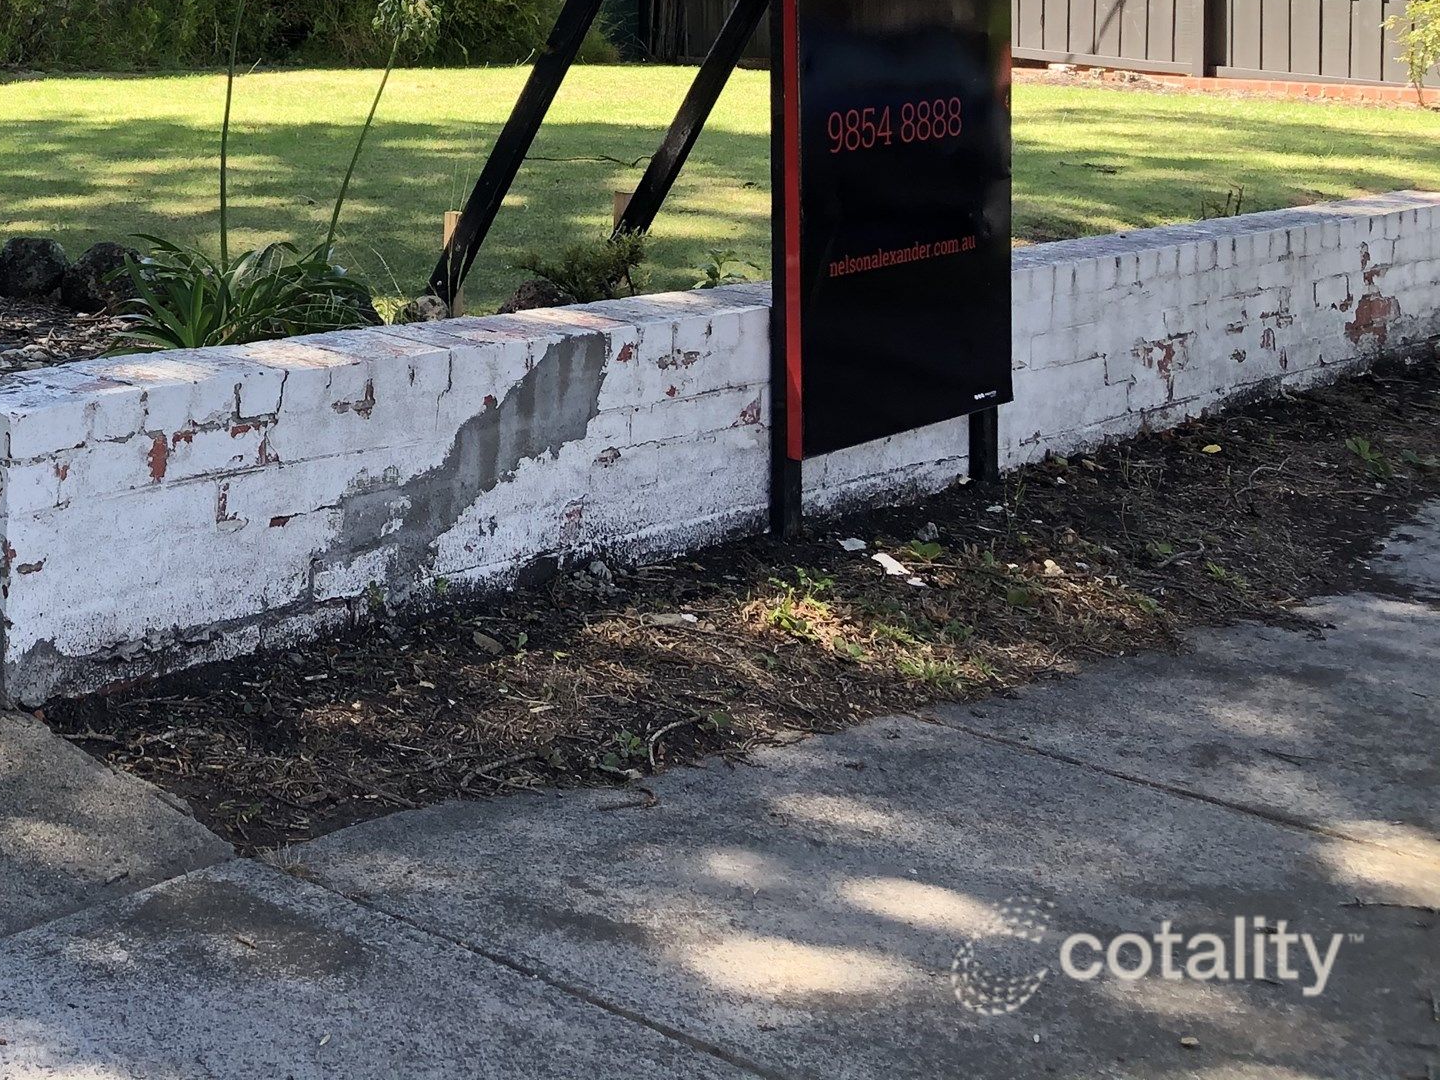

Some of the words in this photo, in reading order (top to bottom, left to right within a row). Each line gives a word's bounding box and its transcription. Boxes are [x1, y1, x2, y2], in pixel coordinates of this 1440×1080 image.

[827, 105, 893, 154] 9854
[900, 96, 962, 143] 8888
[828, 234, 977, 278] nelsonalexander.com.au
